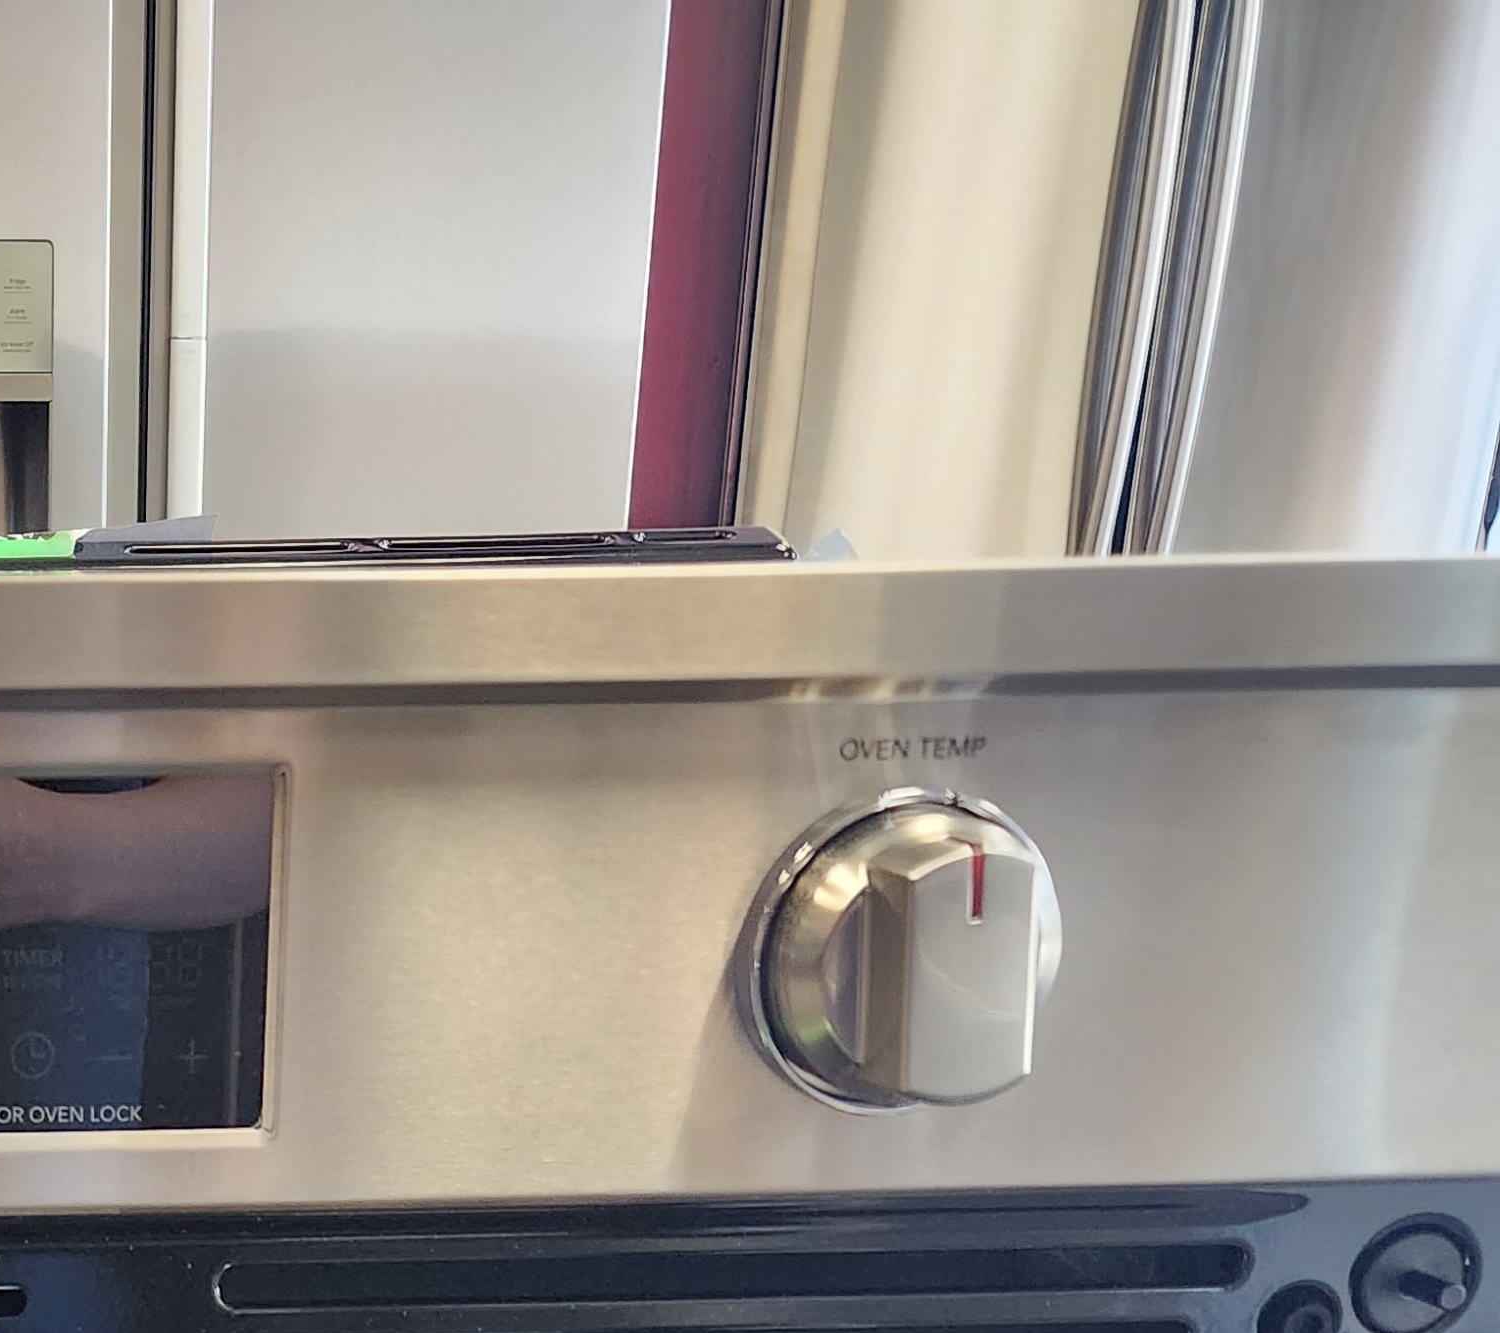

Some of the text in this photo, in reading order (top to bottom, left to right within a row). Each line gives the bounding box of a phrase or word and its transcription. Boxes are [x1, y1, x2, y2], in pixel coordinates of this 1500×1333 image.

[839, 734, 987, 762] OVEN TEMP
[29, 1105, 85, 1123] OVEN
[90, 1104, 143, 1123] LOCK
